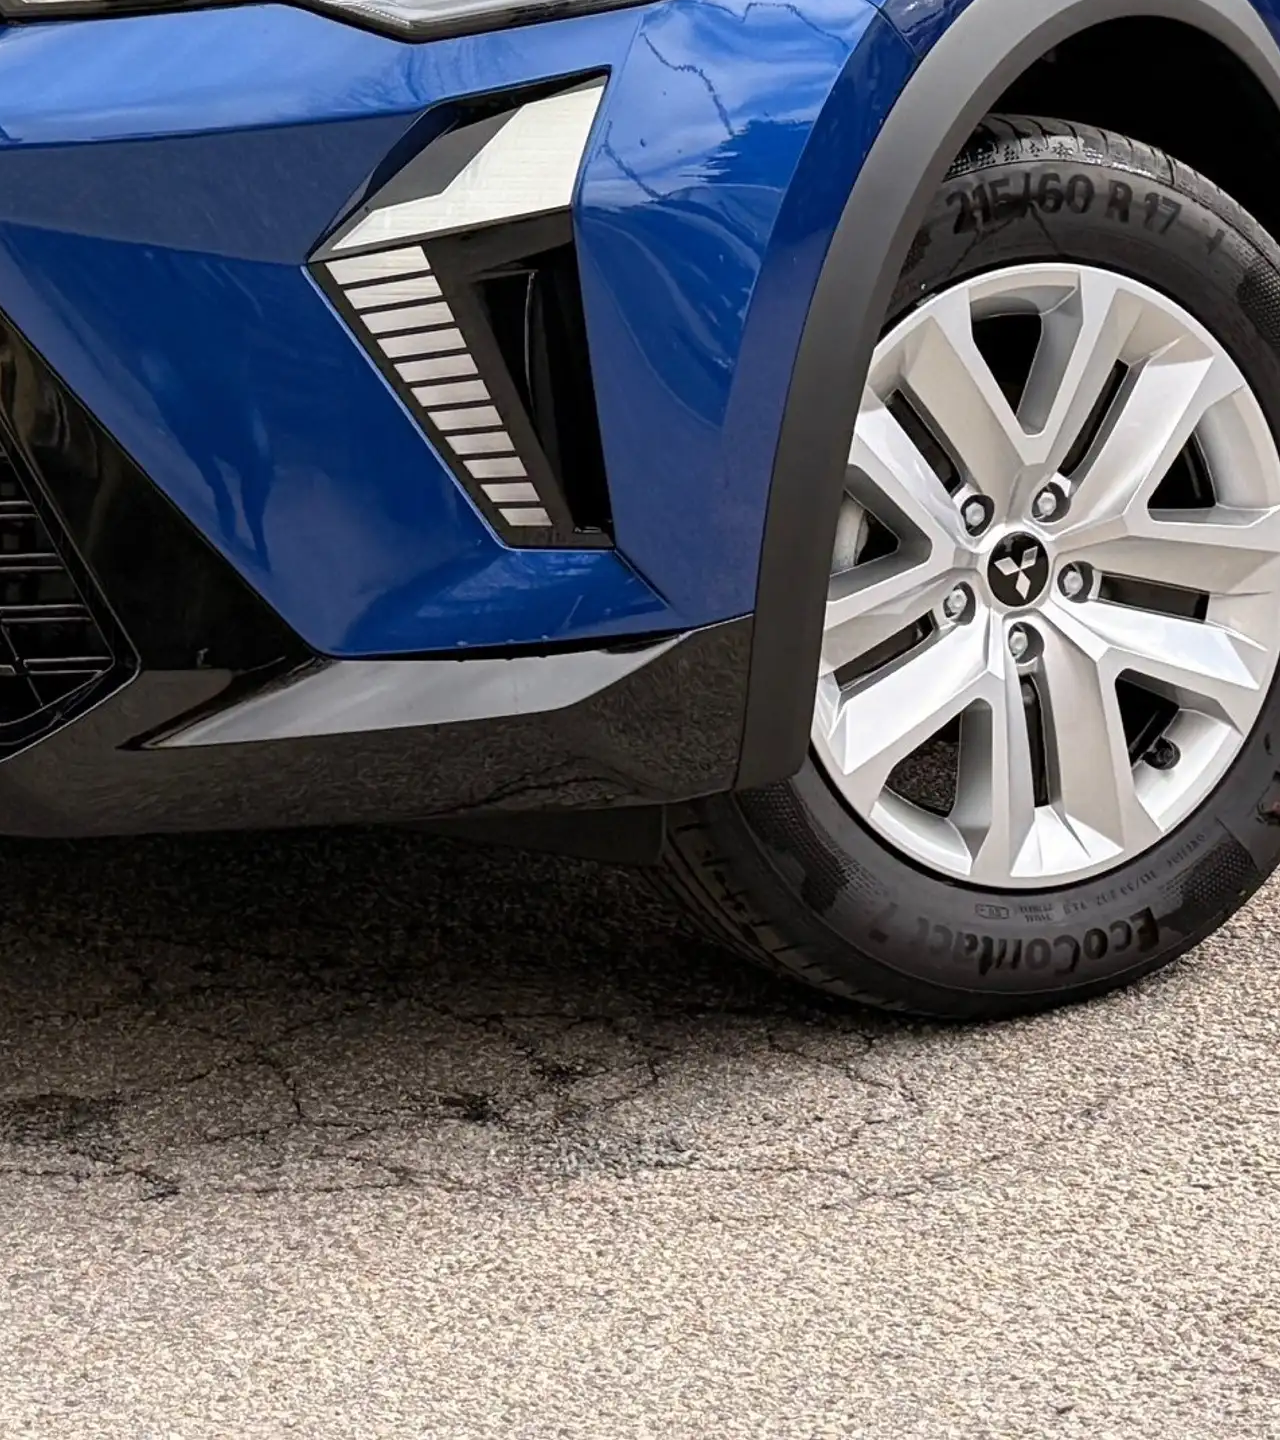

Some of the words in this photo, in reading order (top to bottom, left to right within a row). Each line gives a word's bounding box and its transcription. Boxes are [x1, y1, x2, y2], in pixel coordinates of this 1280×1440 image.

[946, 171, 1095, 235] 215/60
[1105, 179, 1134, 224] R
[1143, 191, 1183, 235] 17
[916, 905, 1160, 976] EcoContact
